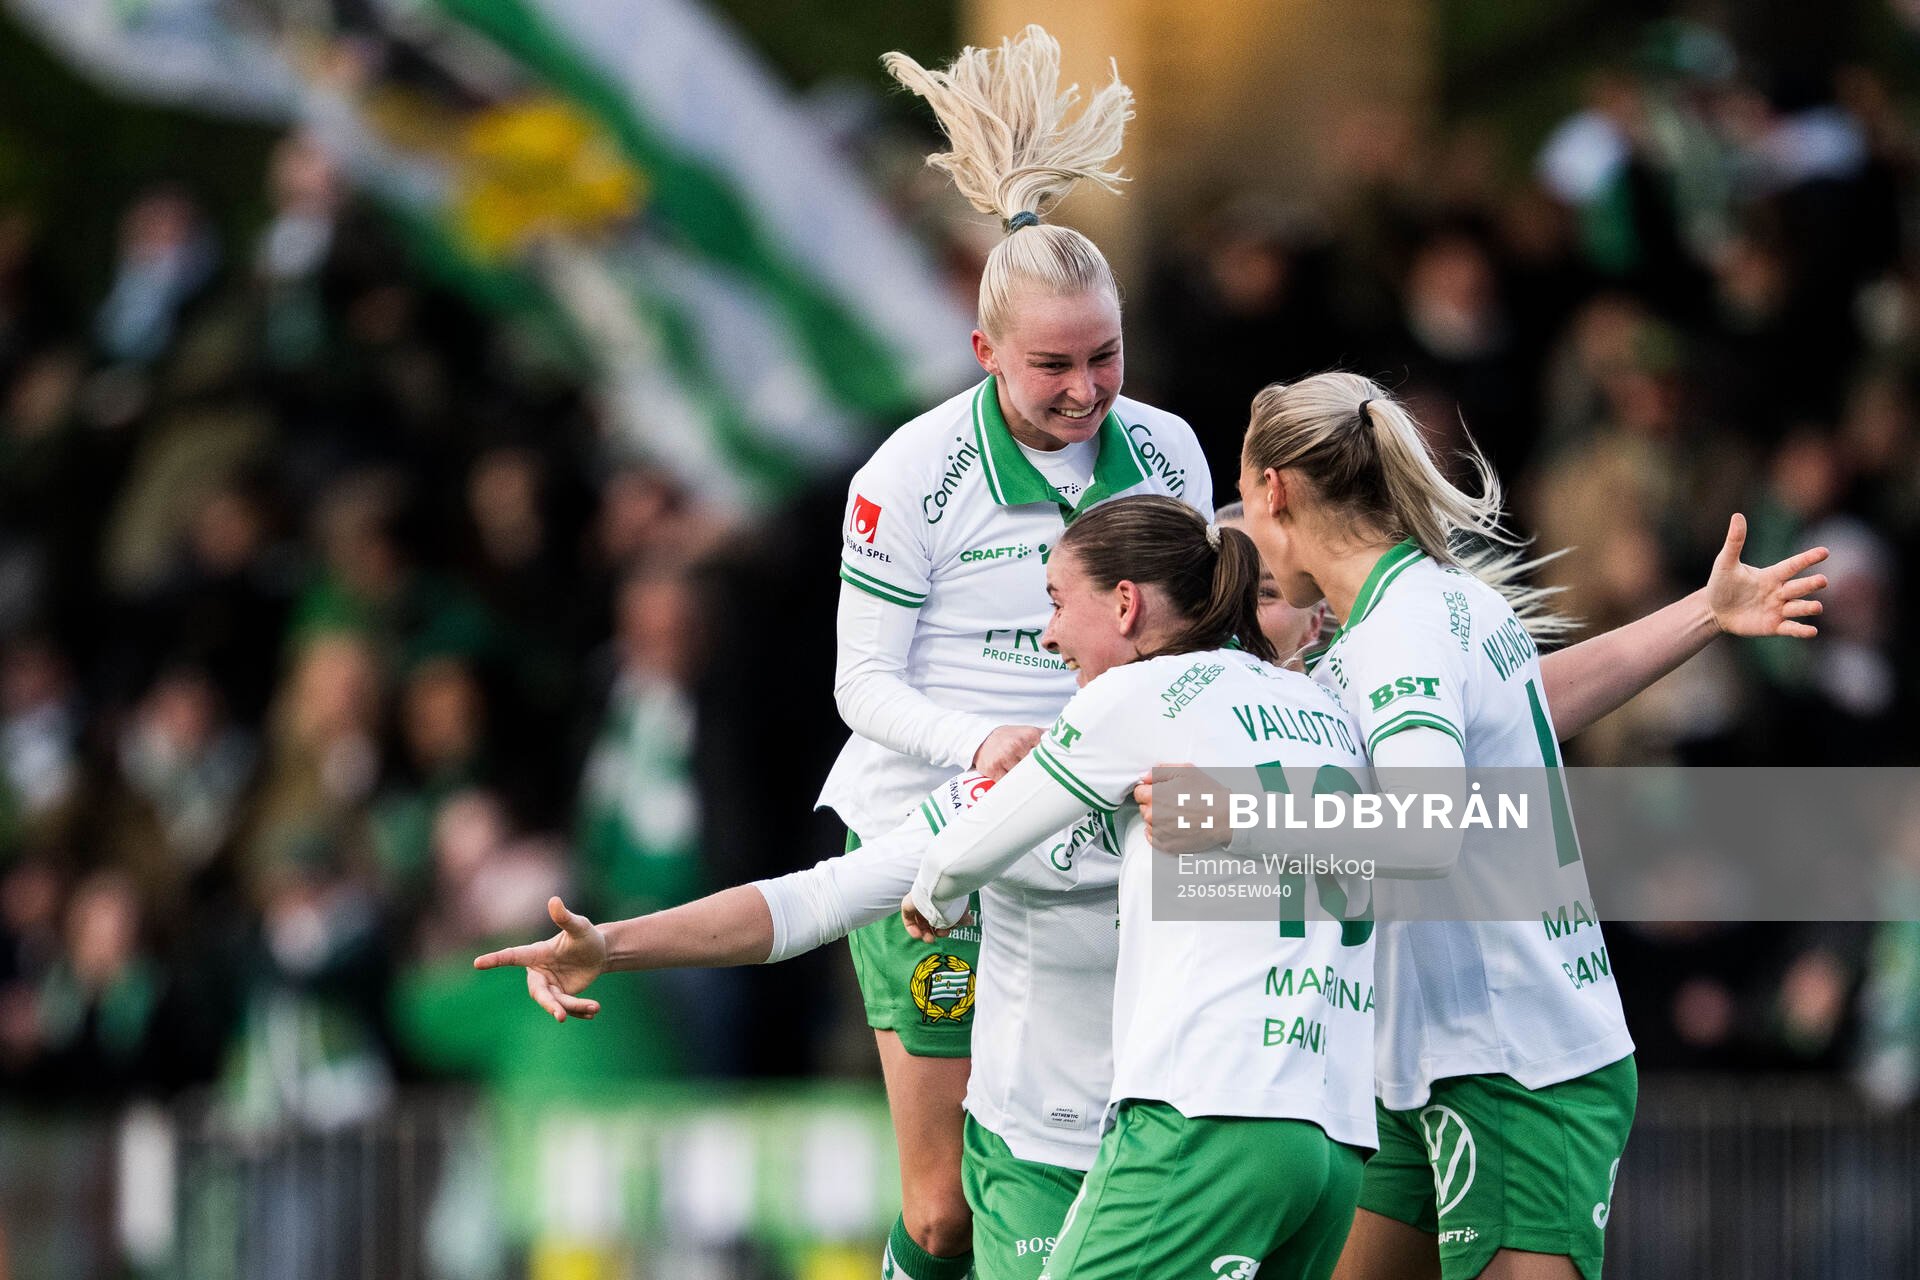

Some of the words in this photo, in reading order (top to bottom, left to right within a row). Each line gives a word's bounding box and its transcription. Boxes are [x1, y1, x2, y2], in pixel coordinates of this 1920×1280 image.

[923, 437, 979, 524] Convini
[866, 548, 892, 563] SPEL
[960, 547, 1016, 562] CRAFT
[982, 647, 1069, 670] PROFESSIONA
[1161, 662, 1207, 703] NORDIC
[1369, 676, 1440, 711] BST
[1051, 716, 1082, 749] ST
[1232, 704, 1357, 756] VALLOTTO
[948, 928, 981, 943] atklu
[1561, 946, 1609, 990] BAN
[1263, 1016, 1327, 1056] BAN
[1015, 1237, 1056, 1257] BOS
